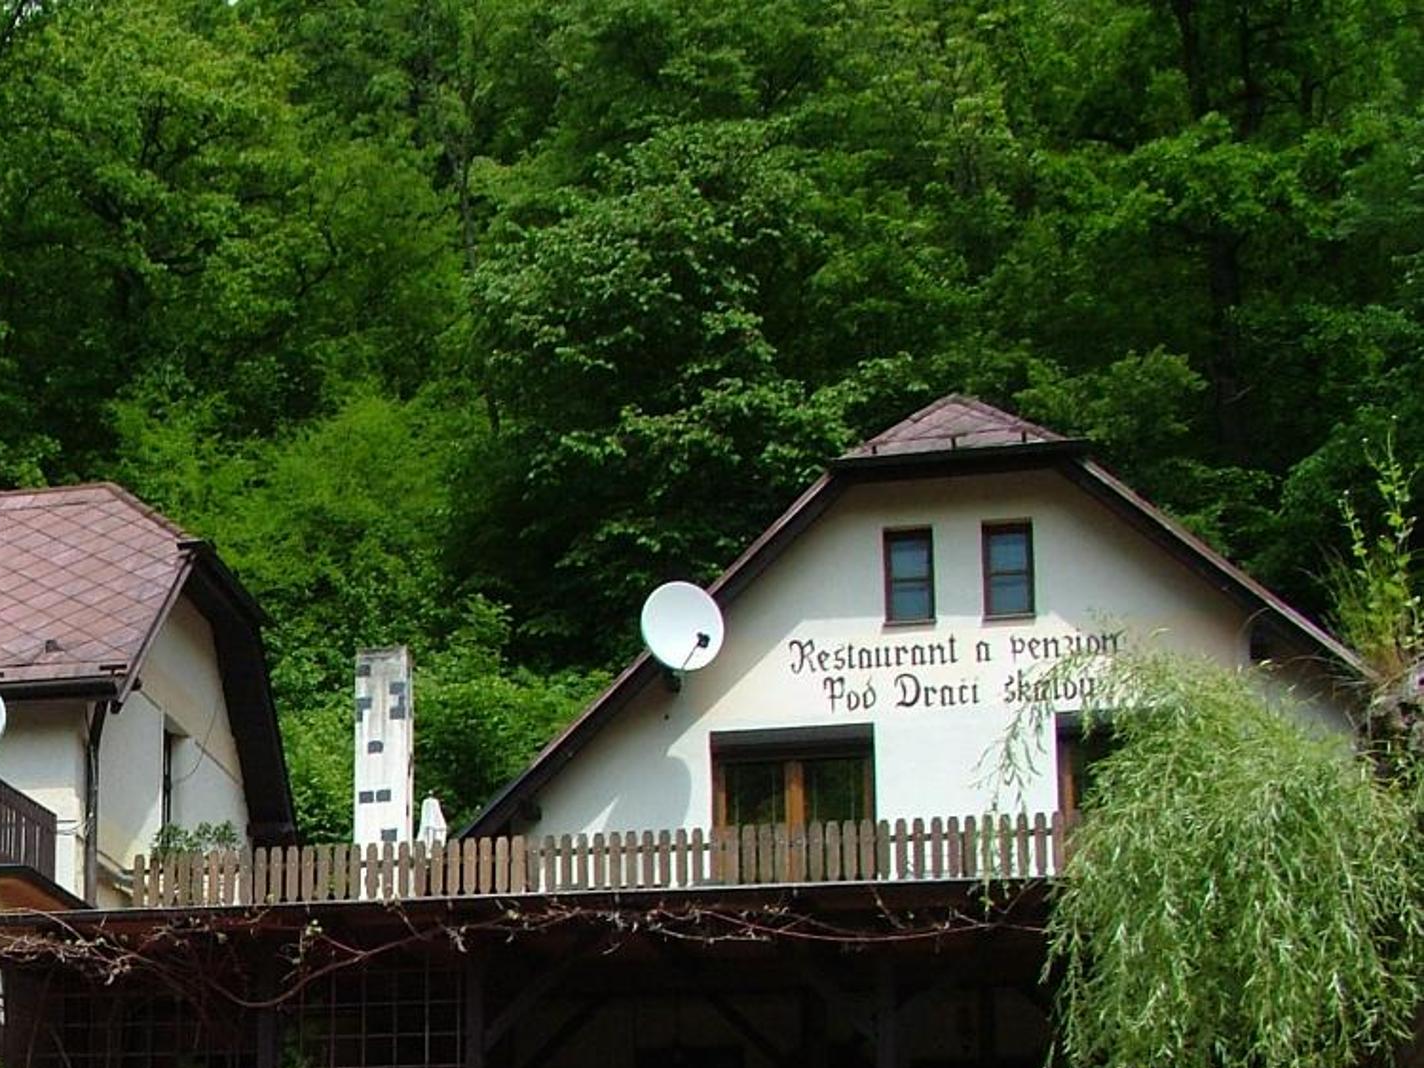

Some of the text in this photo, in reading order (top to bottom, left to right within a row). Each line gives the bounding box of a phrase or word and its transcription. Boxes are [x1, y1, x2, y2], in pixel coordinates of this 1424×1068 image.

[789, 628, 1119, 674] Restaurant a penzion
[824, 676, 876, 713] Pod
